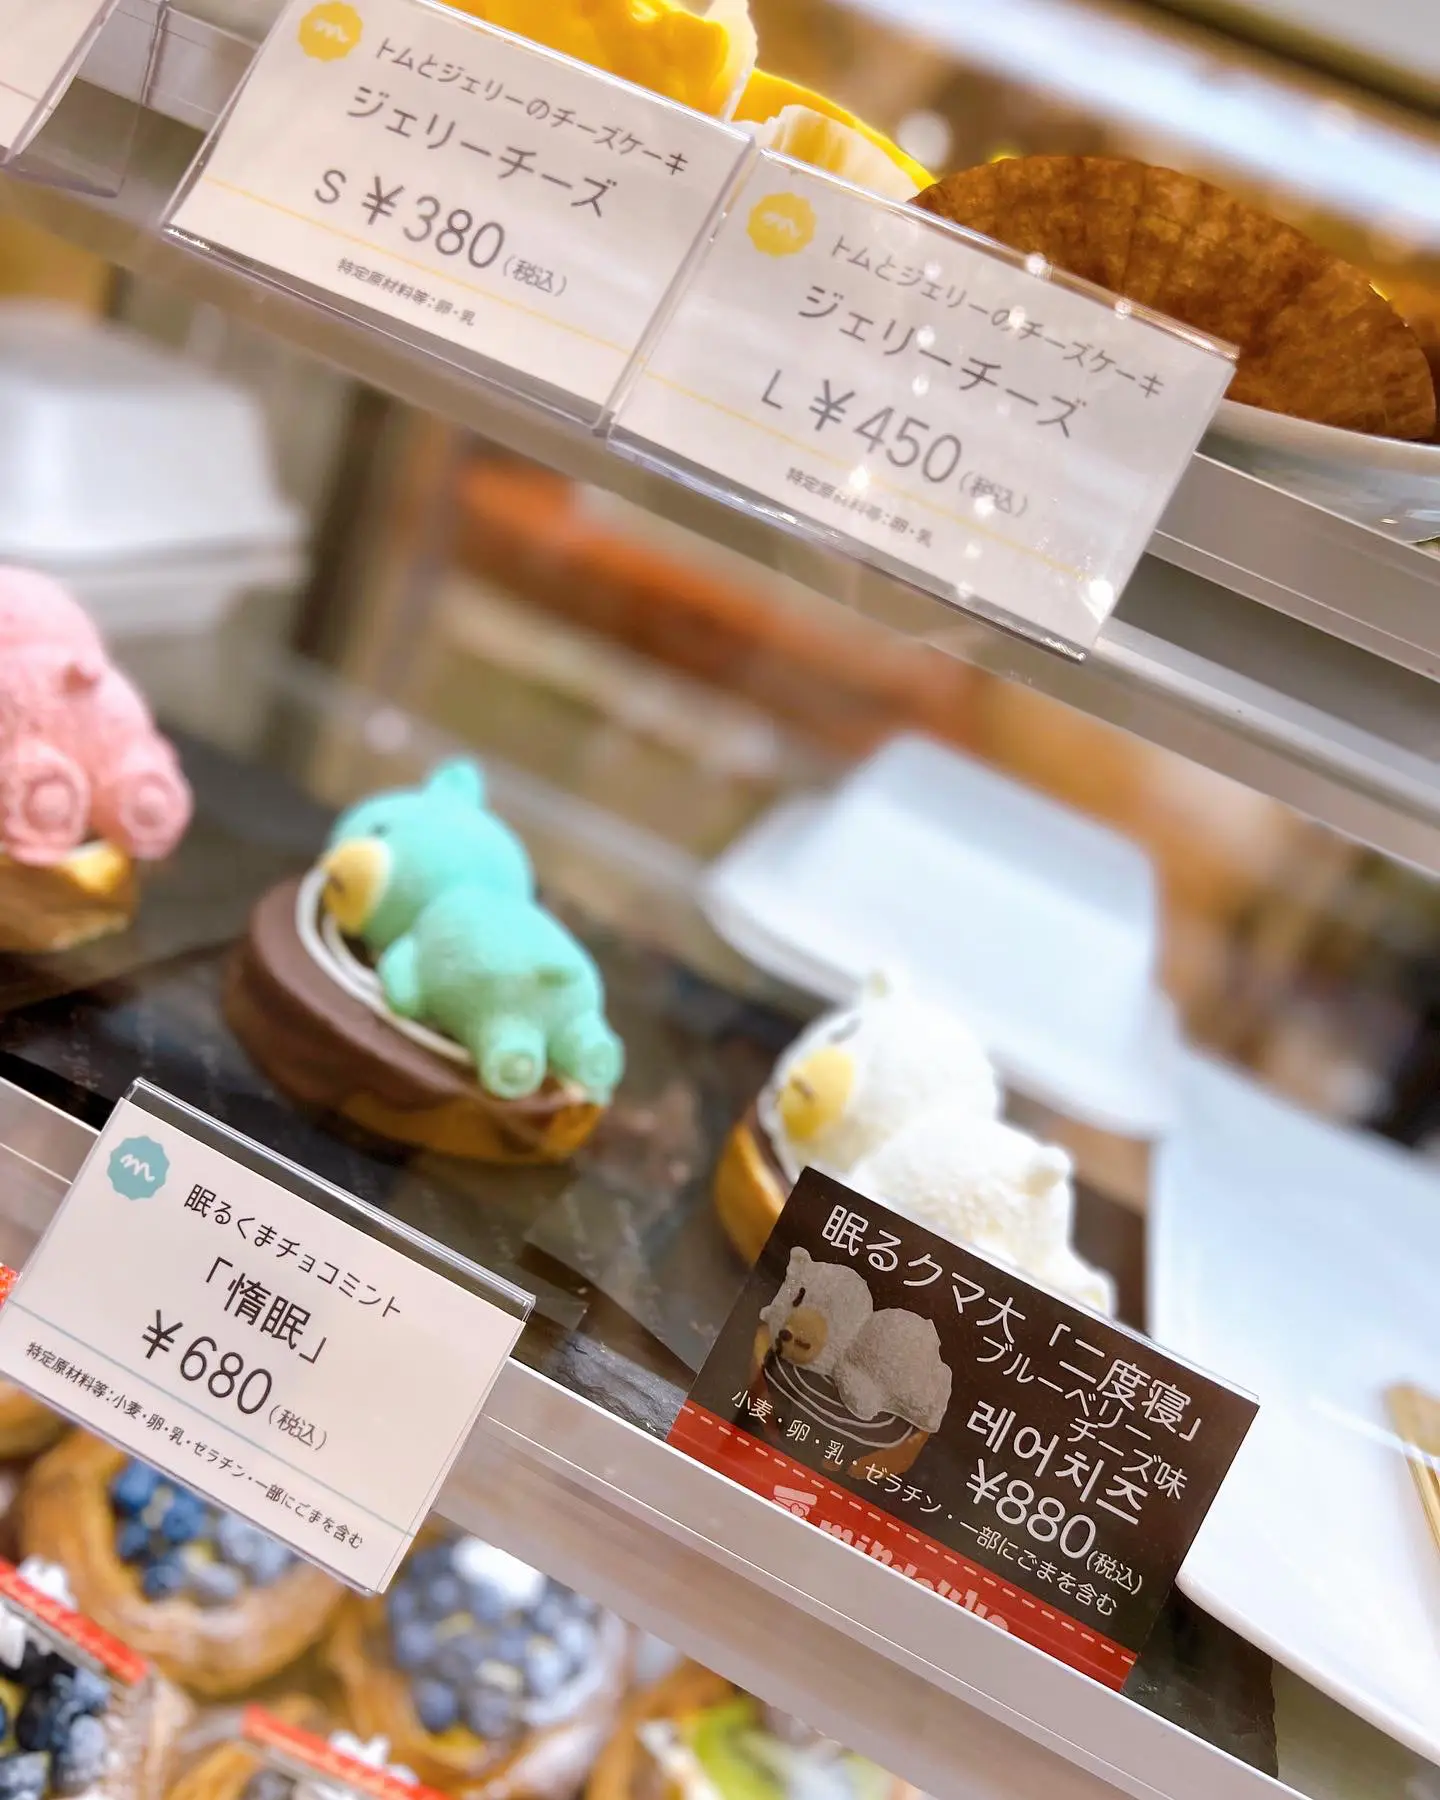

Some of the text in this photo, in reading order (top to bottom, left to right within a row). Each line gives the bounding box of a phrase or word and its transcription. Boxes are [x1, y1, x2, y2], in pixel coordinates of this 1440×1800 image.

[347, 86, 618, 218] ジェリーチーズ
[376, 38, 689, 176] トムとジェリーのチーズケーキ
[314, 168, 347, 205] S
[361, 175, 507, 269] ¥380
[797, 285, 1087, 439] ジェリーチーズ
[831, 235, 1165, 399] トムとジェリーのチーズケーキ
[760, 369, 783, 410] L
[808, 378, 964, 484] ¥450
[183, 1183, 401, 1318] 眠るくまチョコミント
[205, 1256, 327, 1365] 「惰眠」
[141, 1309, 273, 1415] ¥680
[821, 1204, 1202, 1442] 眠るクマ大「二度寝」
[976, 1336, 1152, 1441] ブルーベリー
[965, 1458, 1096, 1559] ¥880
[966, 1400, 1149, 1526] 레어치즈
[1066, 1417, 1188, 1500] チーズ味
